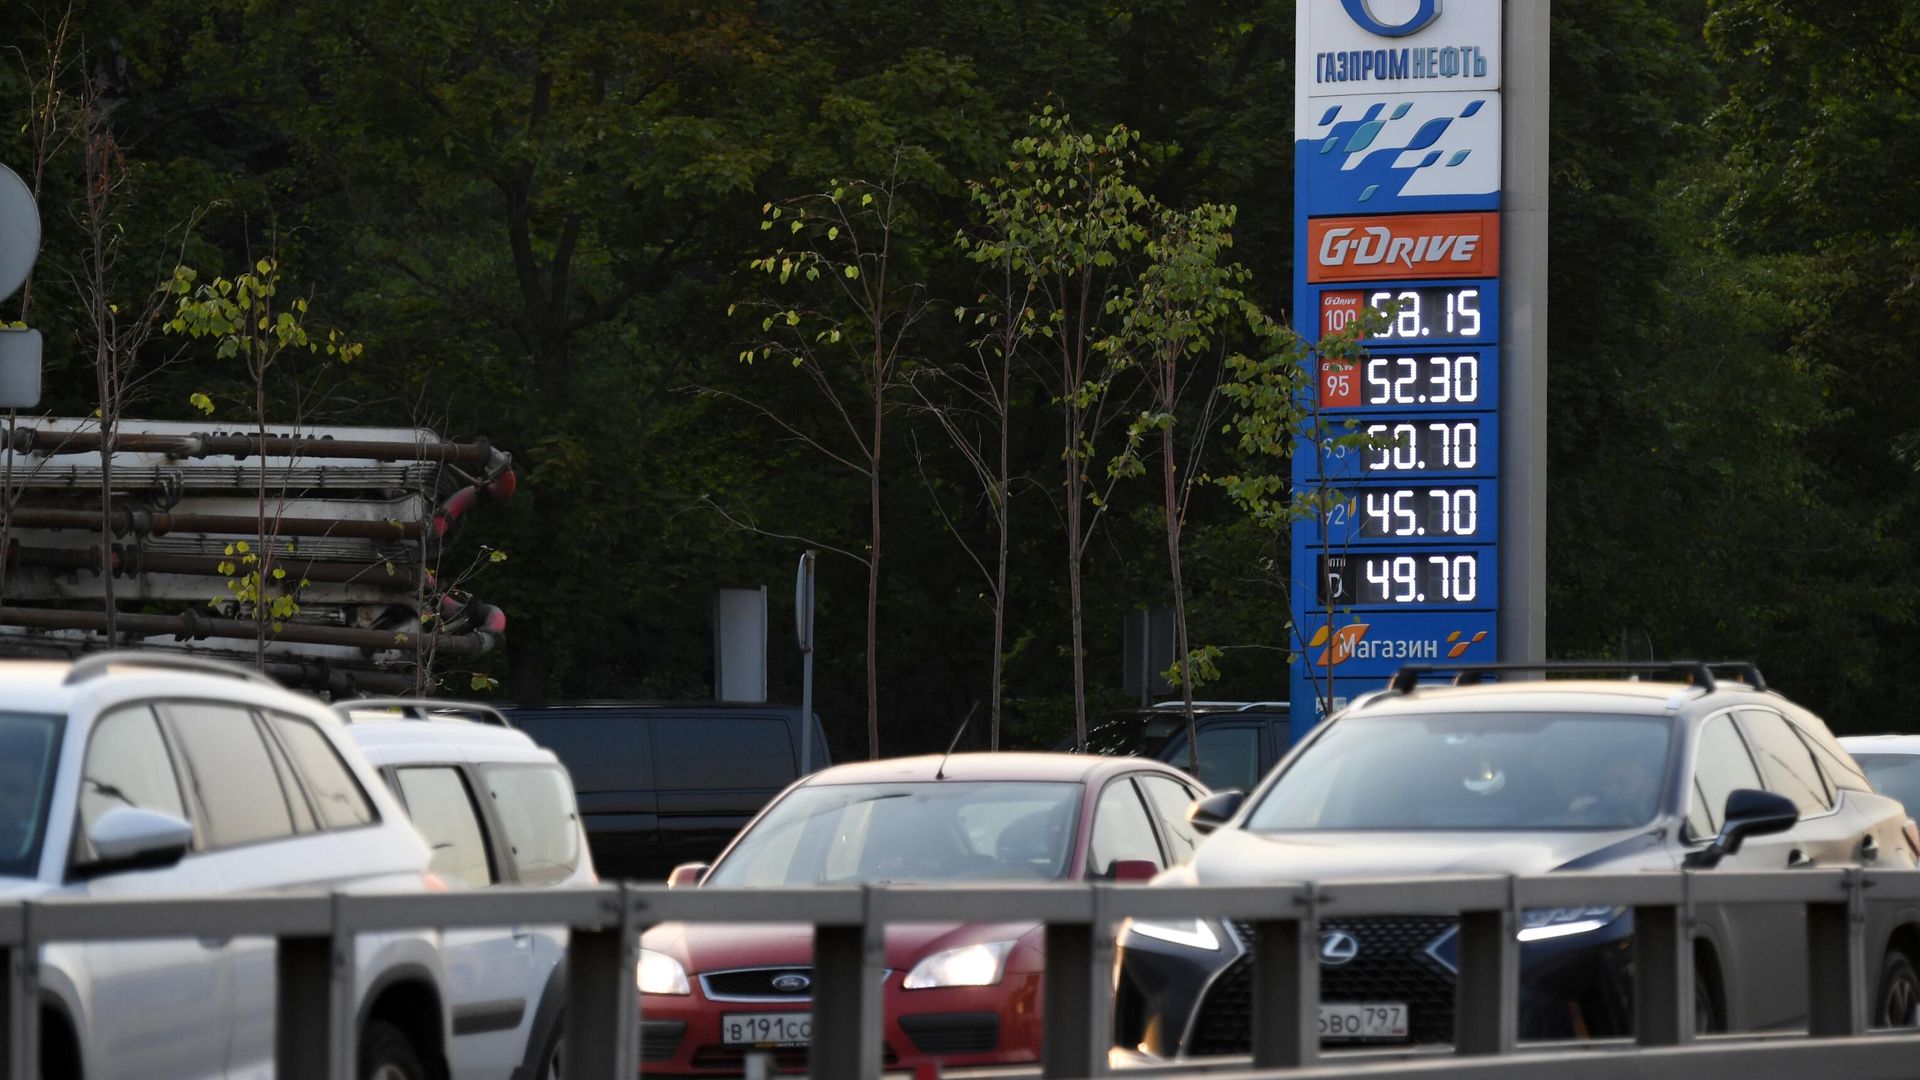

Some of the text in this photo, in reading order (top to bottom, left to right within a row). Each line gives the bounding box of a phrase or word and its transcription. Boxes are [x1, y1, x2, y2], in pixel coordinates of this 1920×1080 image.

[1327, 375, 1349, 396] 95
[1368, 356, 1477, 404] 52.30
[1367, 423, 1476, 470] 50.70
[1367, 489, 1476, 535] 45.70
[1367, 556, 1476, 602] 49.70
[1338, 634, 1438, 659] Магазин
[1364, 1007, 1400, 1027] 797
